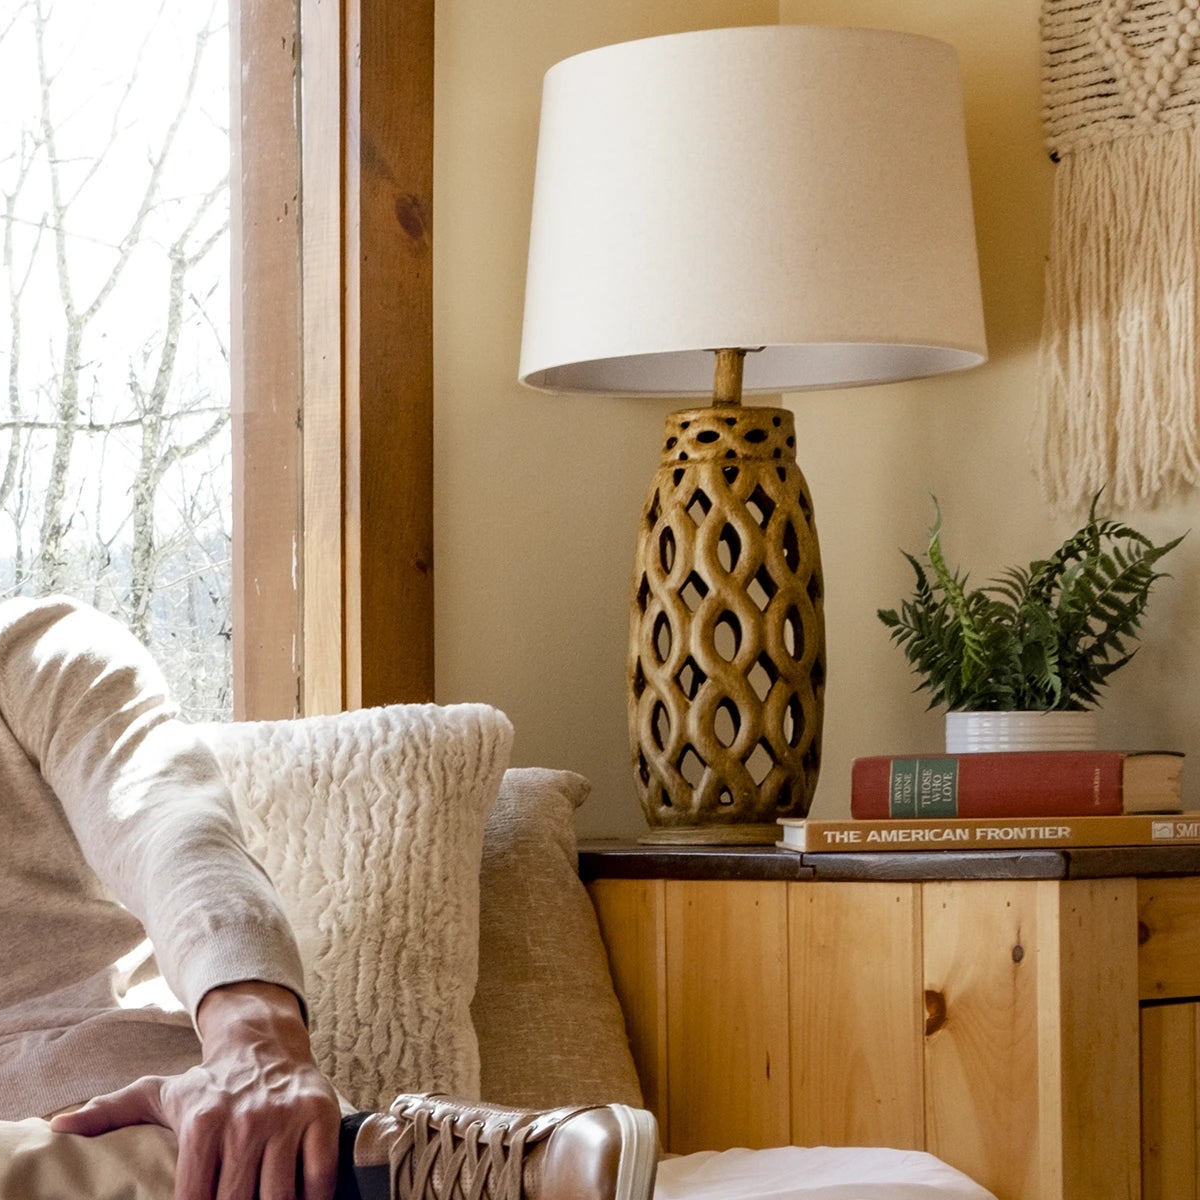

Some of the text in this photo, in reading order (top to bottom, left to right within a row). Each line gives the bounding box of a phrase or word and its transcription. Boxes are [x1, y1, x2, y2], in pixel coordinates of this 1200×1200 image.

[894, 773, 902, 804] IRVING
[903, 773, 912, 804] STONE
[921, 768, 932, 808] THOSE
[932, 774, 942, 802] WHO
[942, 772, 953, 802] LOVE
[823, 826, 1072, 844] THE AMERICAN FRONTIER
